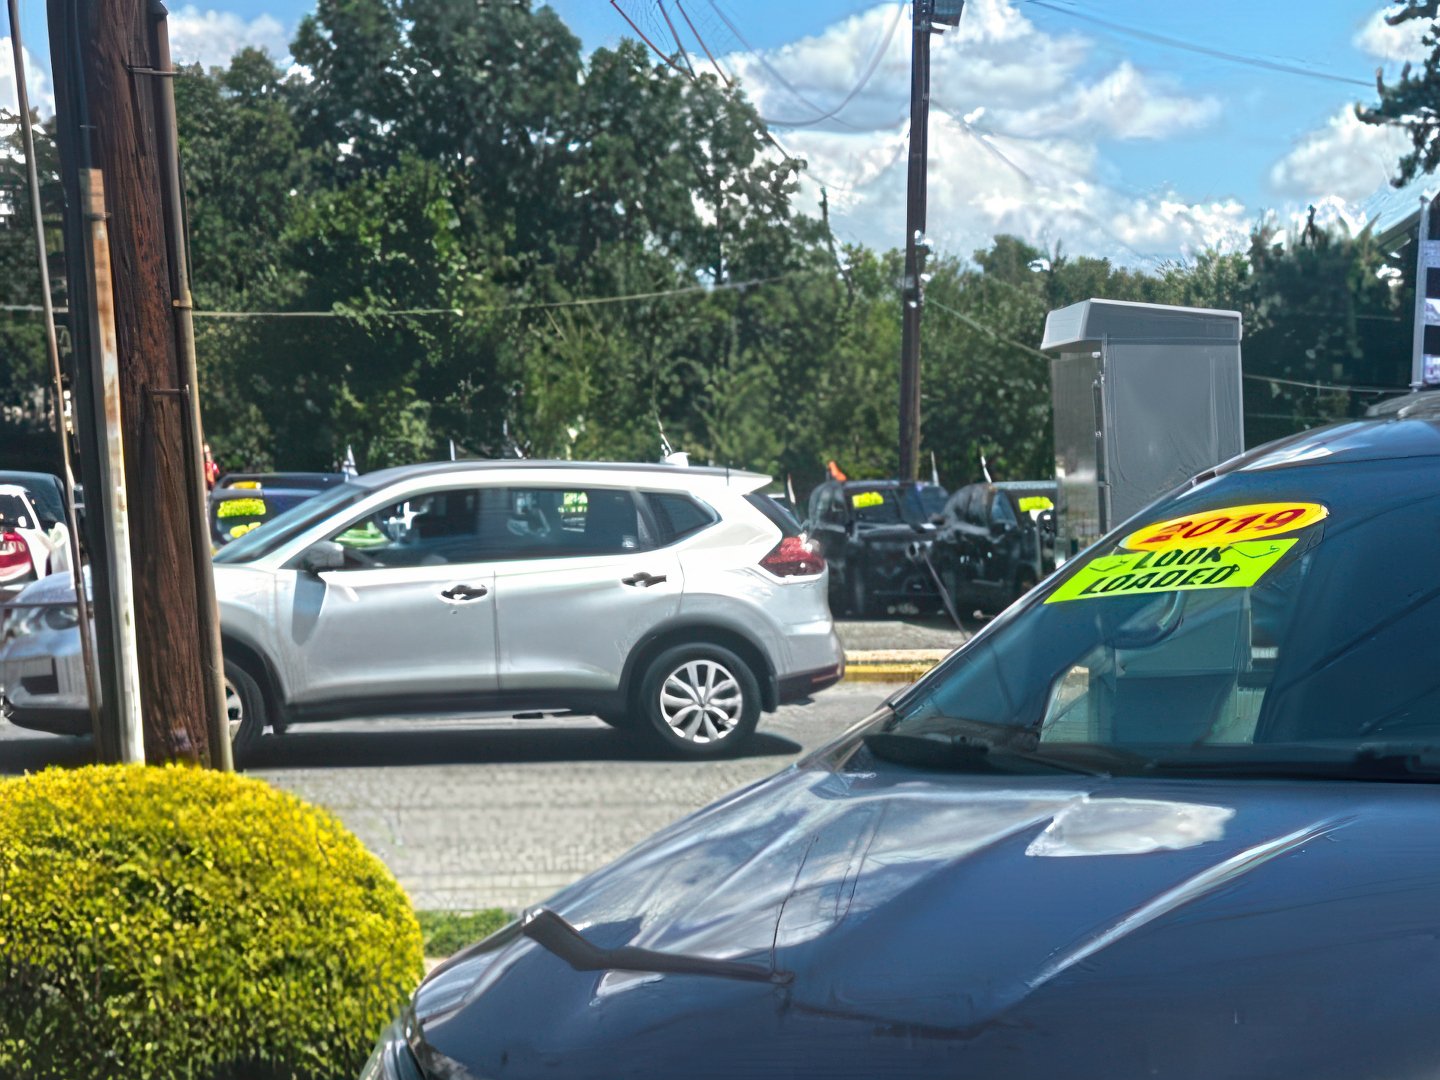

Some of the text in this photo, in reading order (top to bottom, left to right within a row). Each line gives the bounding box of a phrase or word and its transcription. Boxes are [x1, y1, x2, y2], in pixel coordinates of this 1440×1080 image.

[1137, 508, 1306, 545] 2019
[1131, 545, 1233, 571] LOOK
[1078, 565, 1238, 596] LOADED
